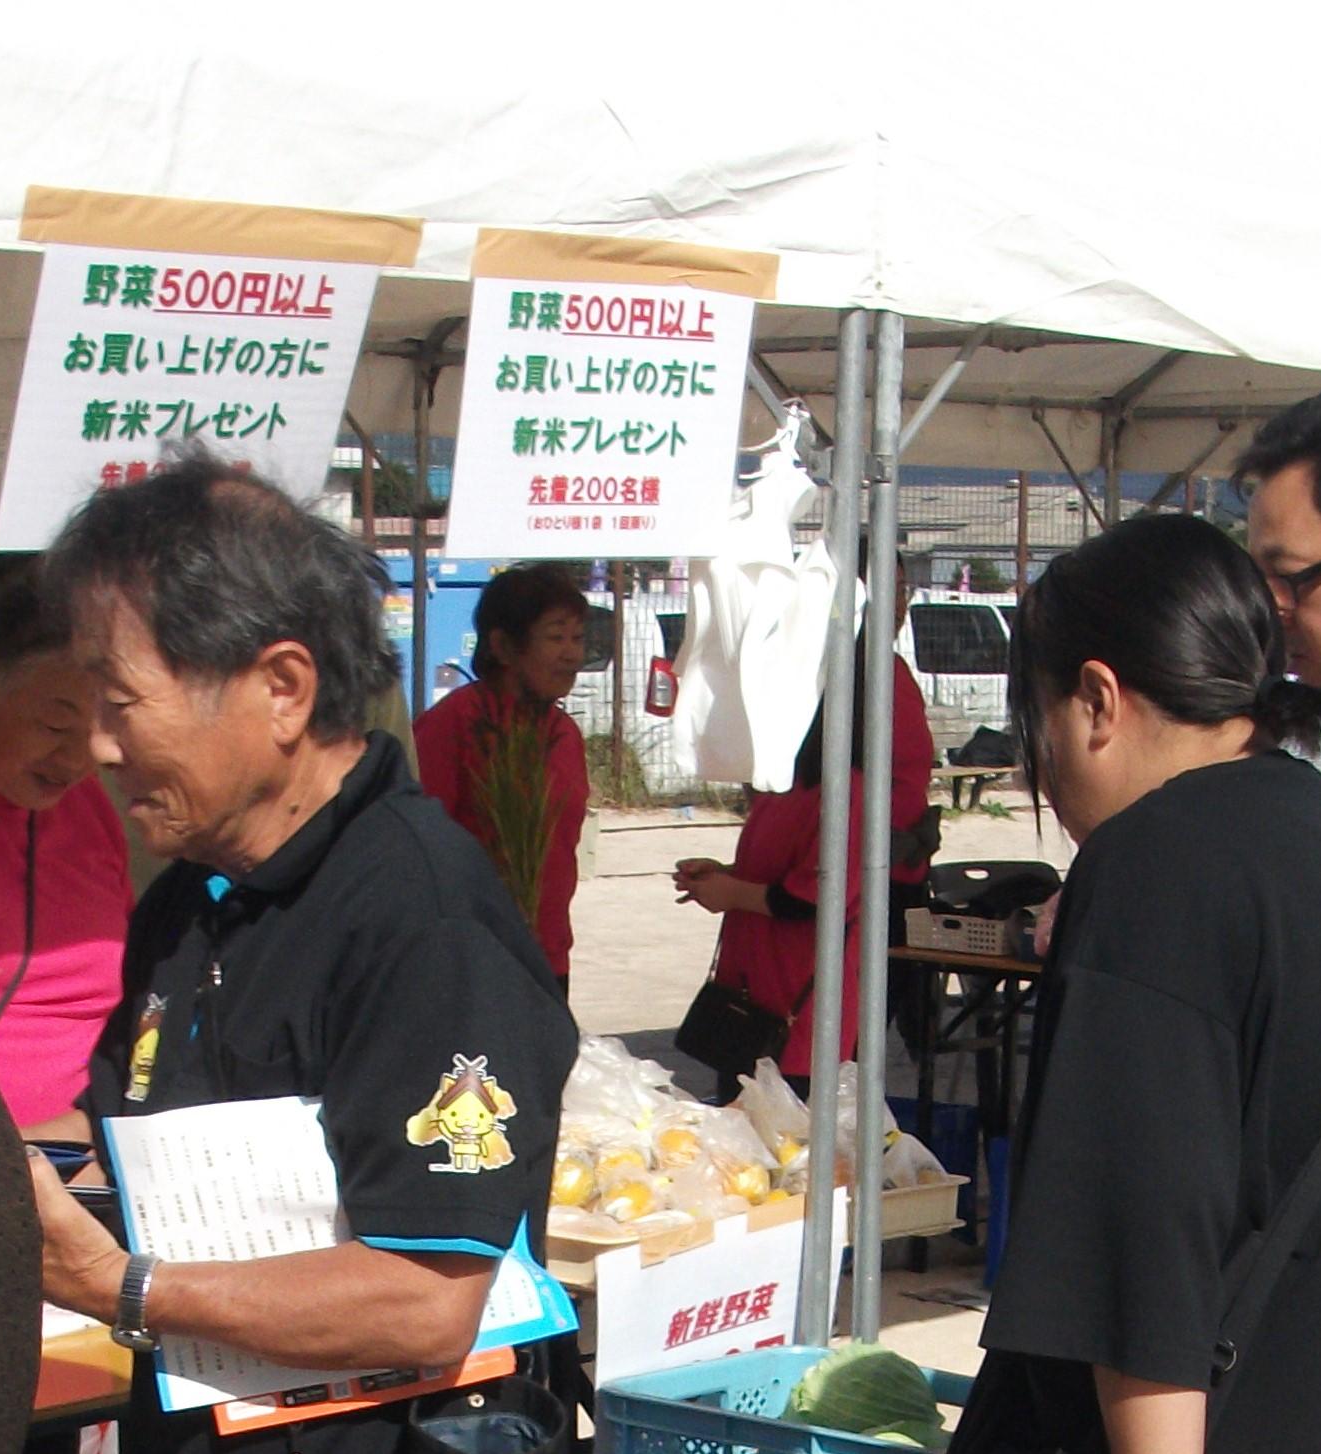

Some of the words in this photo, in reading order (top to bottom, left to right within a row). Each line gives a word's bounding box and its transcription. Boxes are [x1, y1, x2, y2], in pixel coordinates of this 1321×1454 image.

[83, 263, 336, 316] 野菜500円以上
[508, 291, 715, 339] 野菜500円以上
[63, 332, 331, 379] お買い上げの方に
[495, 354, 717, 398] お買い上げの方に
[81, 400, 288, 442] 新米プレゼント
[511, 415, 688, 456] 新米プレゼント
[529, 475, 661, 504] 先着200名様
[665, 1281, 780, 1347] 新鮮野菜
